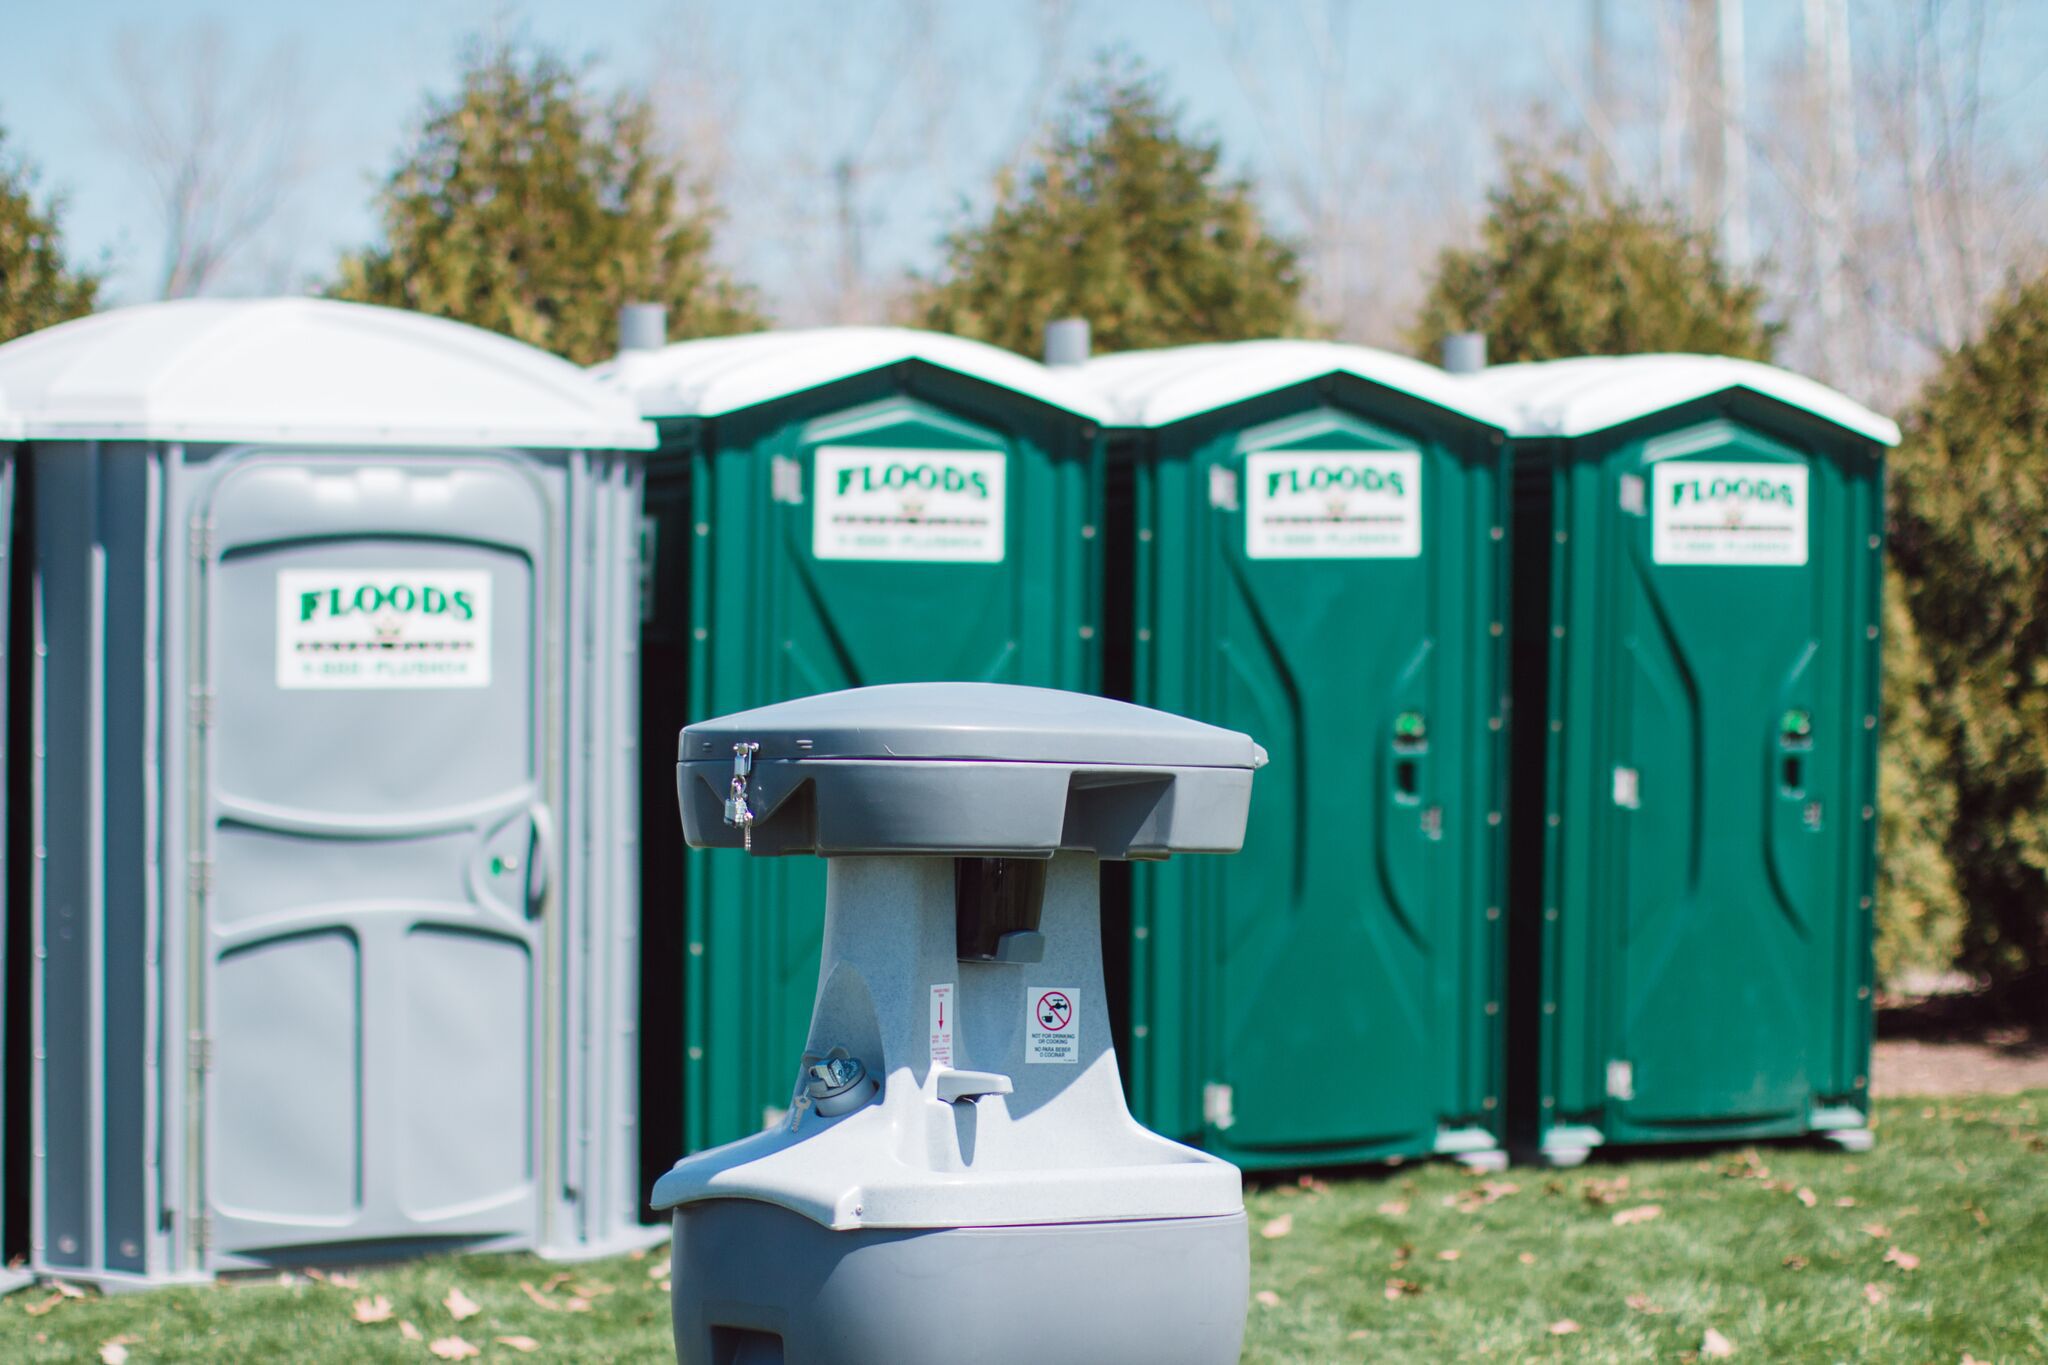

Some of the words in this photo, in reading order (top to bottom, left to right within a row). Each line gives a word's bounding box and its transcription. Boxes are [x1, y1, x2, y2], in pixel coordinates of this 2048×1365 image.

[837, 464, 989, 499] FLOODS
[1268, 465, 1404, 498] FLOODS
[1673, 478, 1793, 507] FLOODS
[299, 584, 475, 622] FLOODS
